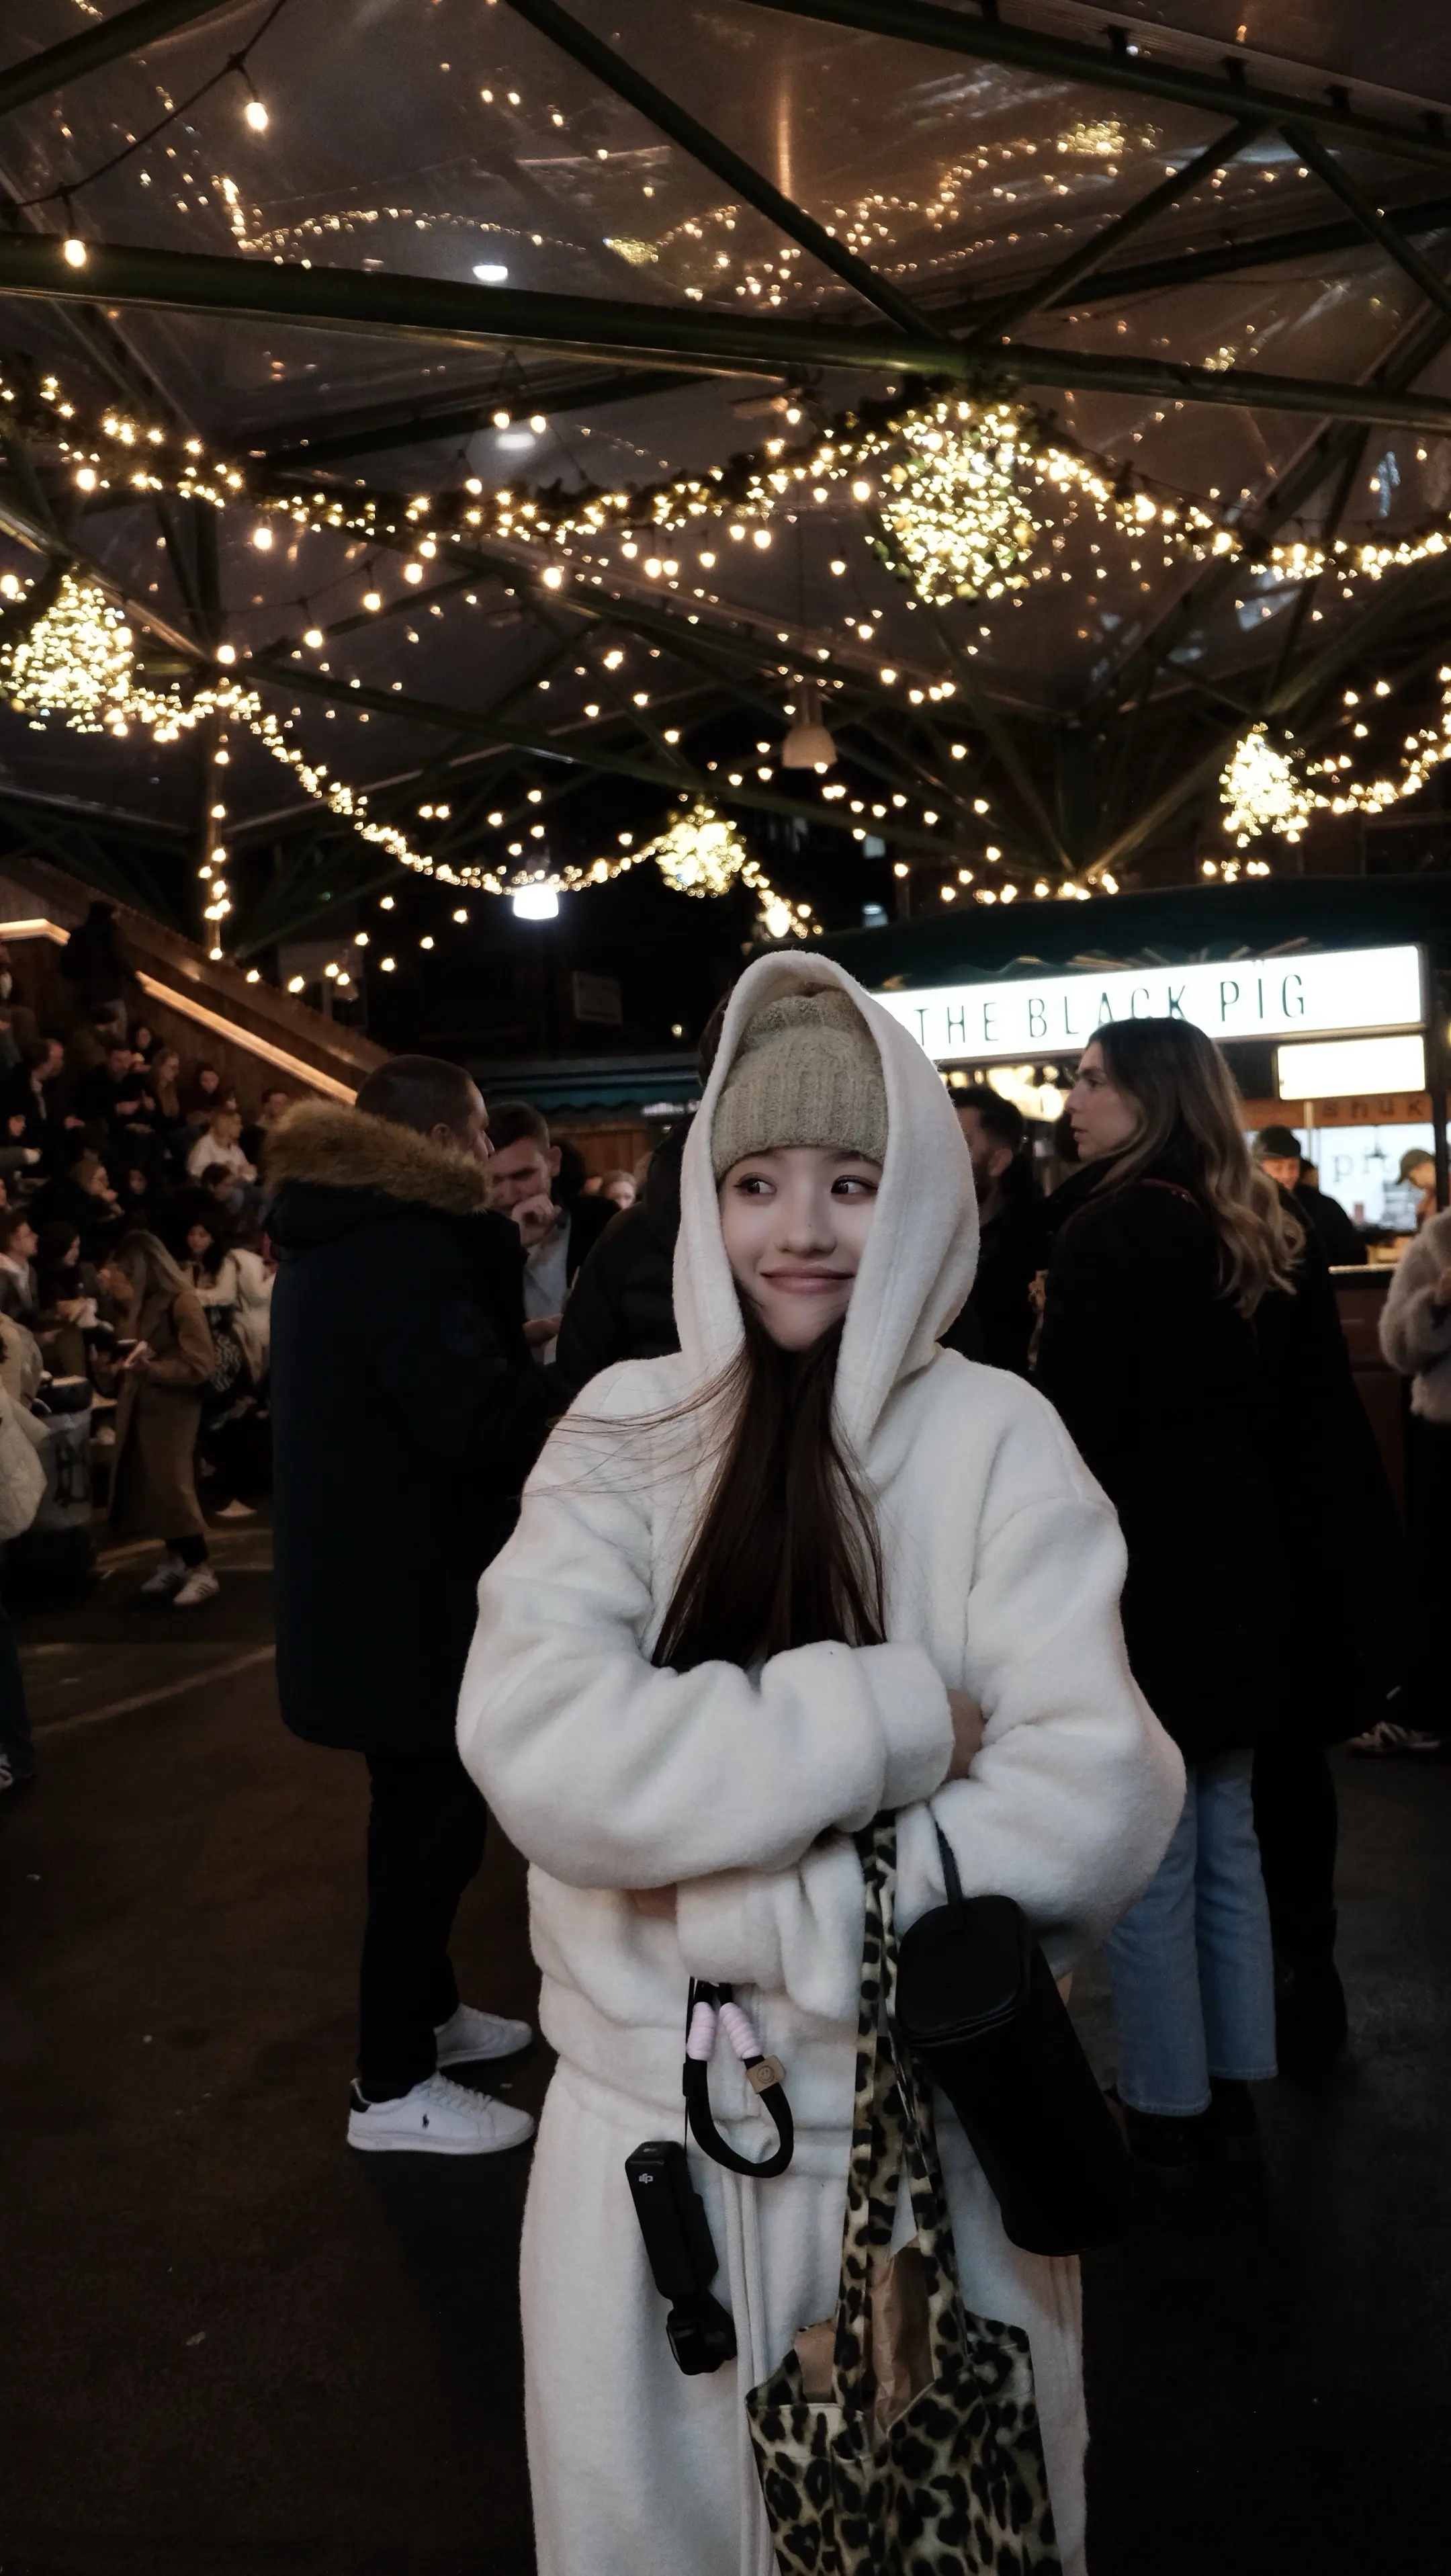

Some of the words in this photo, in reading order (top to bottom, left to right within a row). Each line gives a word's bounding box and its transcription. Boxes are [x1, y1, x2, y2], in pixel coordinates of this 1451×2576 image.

[914, 1002, 999, 1046] THE
[1028, 985, 1186, 1037] BLACK
[1220, 974, 1304, 1022] PIG
